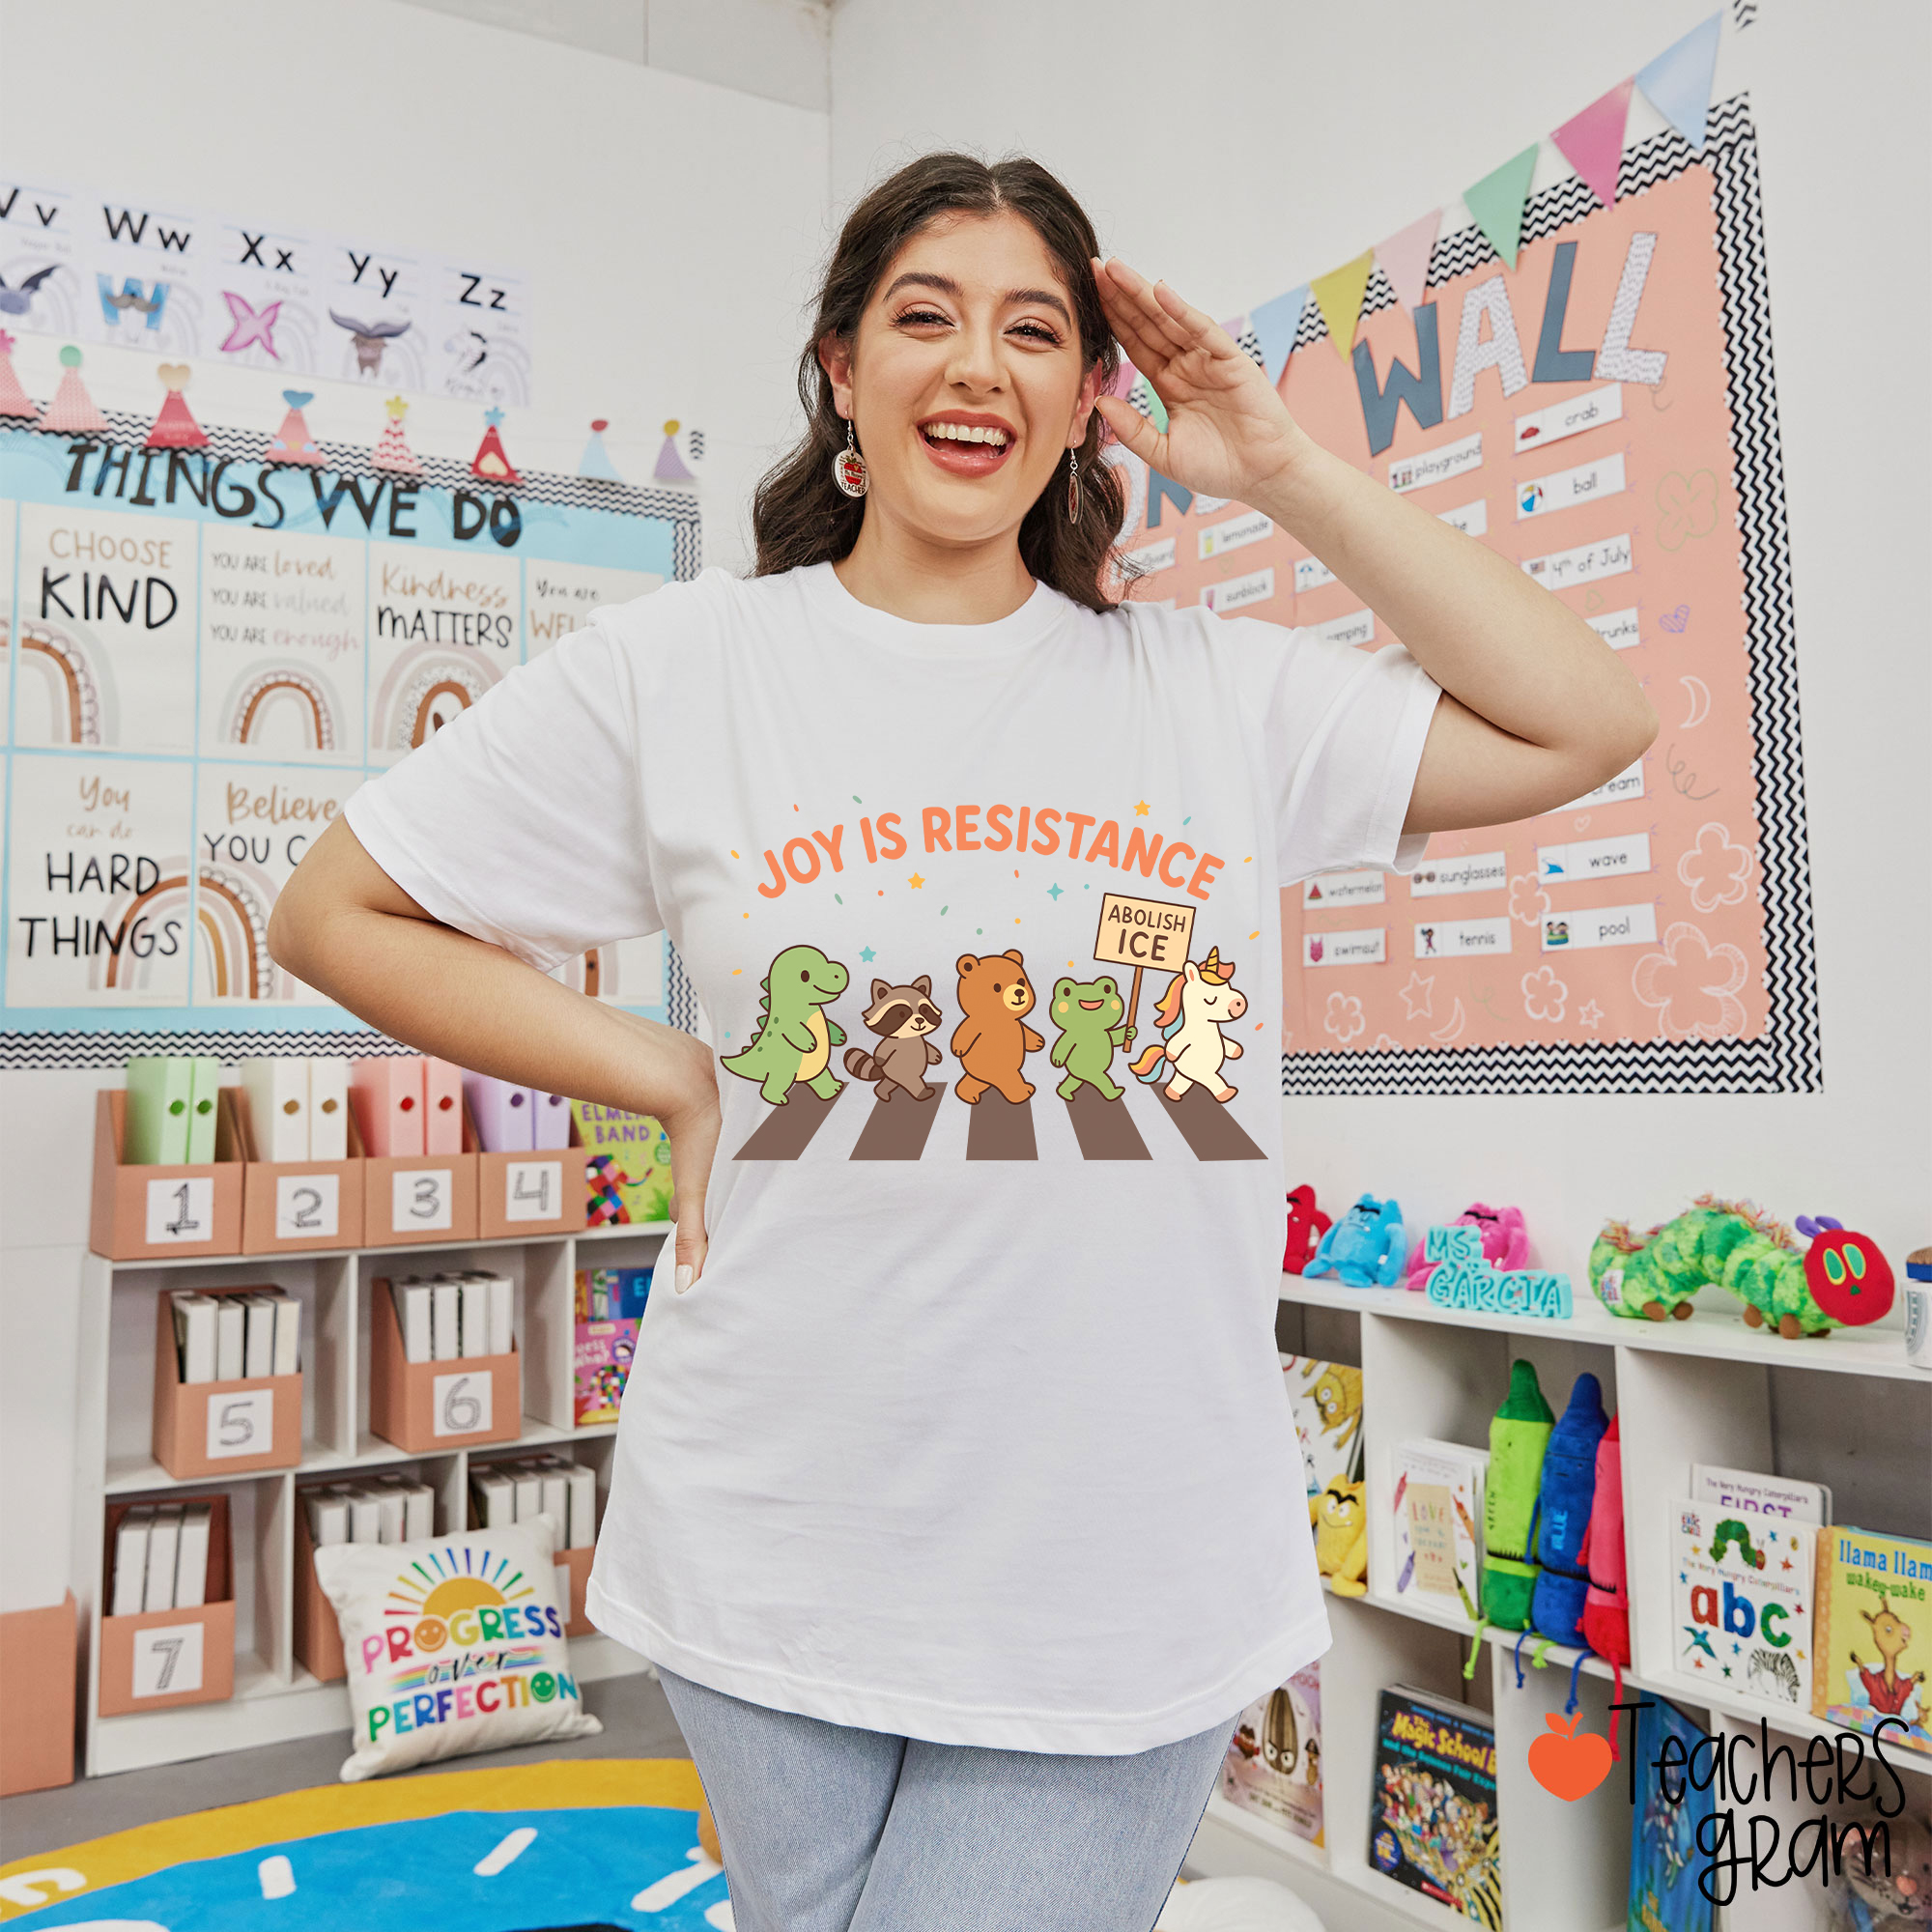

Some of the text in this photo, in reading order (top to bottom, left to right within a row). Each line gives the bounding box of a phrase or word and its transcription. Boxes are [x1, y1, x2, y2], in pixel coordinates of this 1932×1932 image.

[1352, 232, 1668, 458] WALL
[1564, 402, 1599, 427] crab
[1414, 439, 1483, 478] playground
[65, 442, 522, 548] THINGS WE DO
[1573, 471, 1598, 496] ball
[49, 528, 172, 569] CHOOSE
[212, 550, 334, 580] YOU ARE loved
[1577, 553, 1595, 573] of
[1599, 545, 1630, 568] July
[41, 565, 179, 630] KIND
[211, 588, 239, 606] YOU
[243, 592, 266, 610] ARE
[382, 562, 509, 609] Kindness
[210, 624, 238, 642] YOU
[242, 627, 265, 645] ARE
[79, 776, 129, 811] You
[226, 781, 338, 825] Believe
[204, 834, 270, 864] YOU
[757, 804, 1225, 900] JOY IS RESISTANCE
[1589, 853, 1628, 867] wave
[46, 851, 159, 895] HARD
[1438, 863, 1506, 886] sunglasses
[18, 916, 182, 958] THINGS
[1107, 903, 1187, 933] ABOLISH
[1599, 915, 1631, 941] pool
[1118, 928, 1168, 962] ICE
[1459, 930, 1496, 947] tennis
[595, 1124, 650, 1144] BAND
[165, 1182, 200, 1236] 1
[291, 1187, 323, 1228] 2
[410, 1178, 440, 1218] 3
[513, 1169, 549, 1211] 4
[1429, 1229, 1470, 1262] MS
[1429, 1267, 1563, 1318] GARCIA
[219, 1401, 255, 1446] 5
[442, 1377, 482, 1432] 6
[1839, 1539, 1888, 1573] llama
[1690, 1580, 1793, 1648] abc
[362, 1605, 562, 1676] PROGRESS
[152, 1638, 185, 1690] 7
[427, 1651, 511, 1685] over
[368, 1671, 579, 1743] PERFECTION
[1391, 1712, 1435, 1749] Magic
[1435, 1727, 1488, 1771] School
